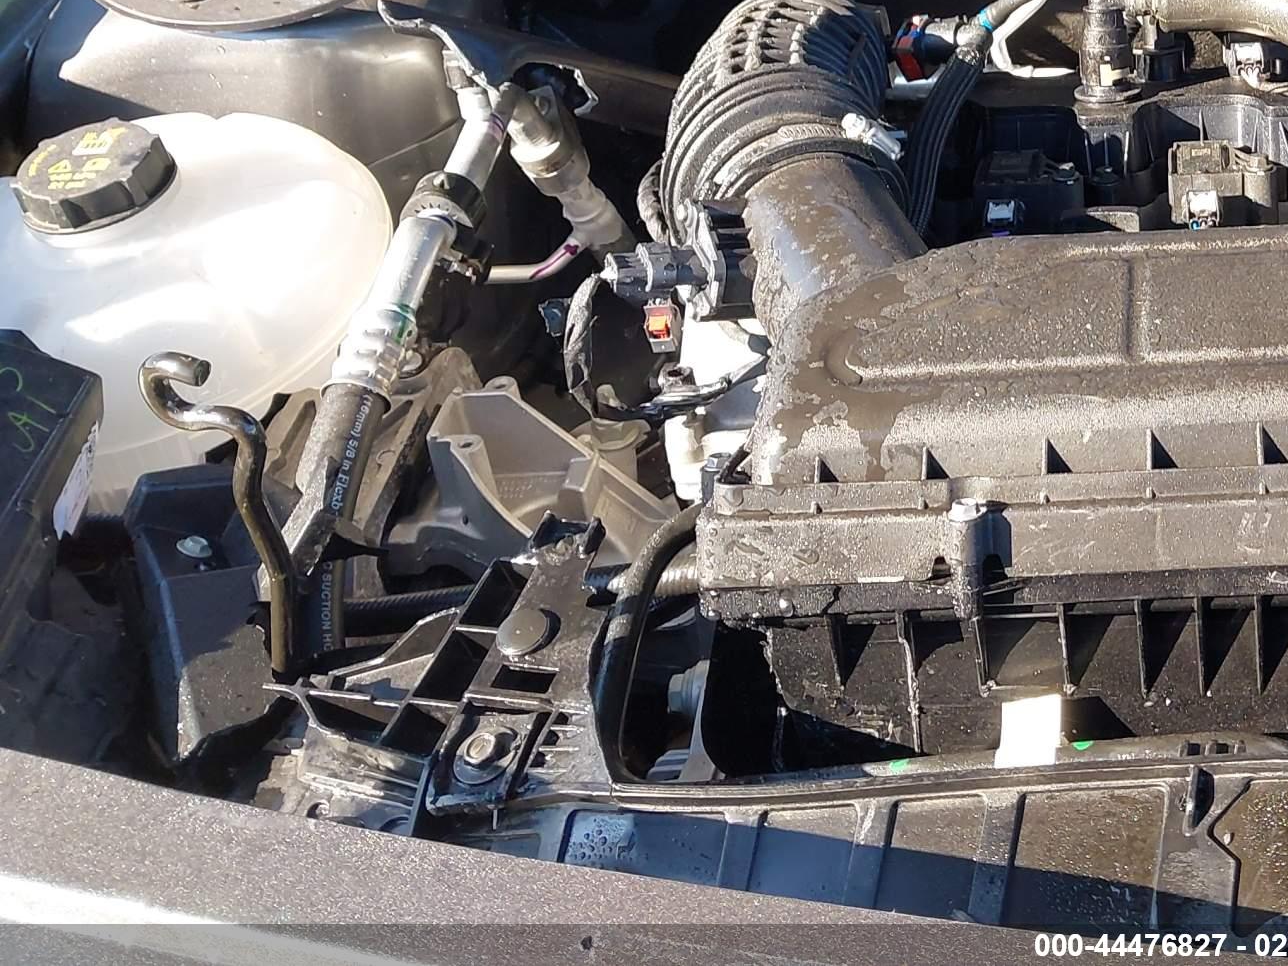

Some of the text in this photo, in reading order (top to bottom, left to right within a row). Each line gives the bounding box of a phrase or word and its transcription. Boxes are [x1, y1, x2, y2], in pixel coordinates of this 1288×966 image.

[350, 394, 374, 437] (16mm)
[345, 439, 359, 459] 5/8
[331, 473, 350, 515] Flexb
[321, 573, 333, 630] SUCTION
